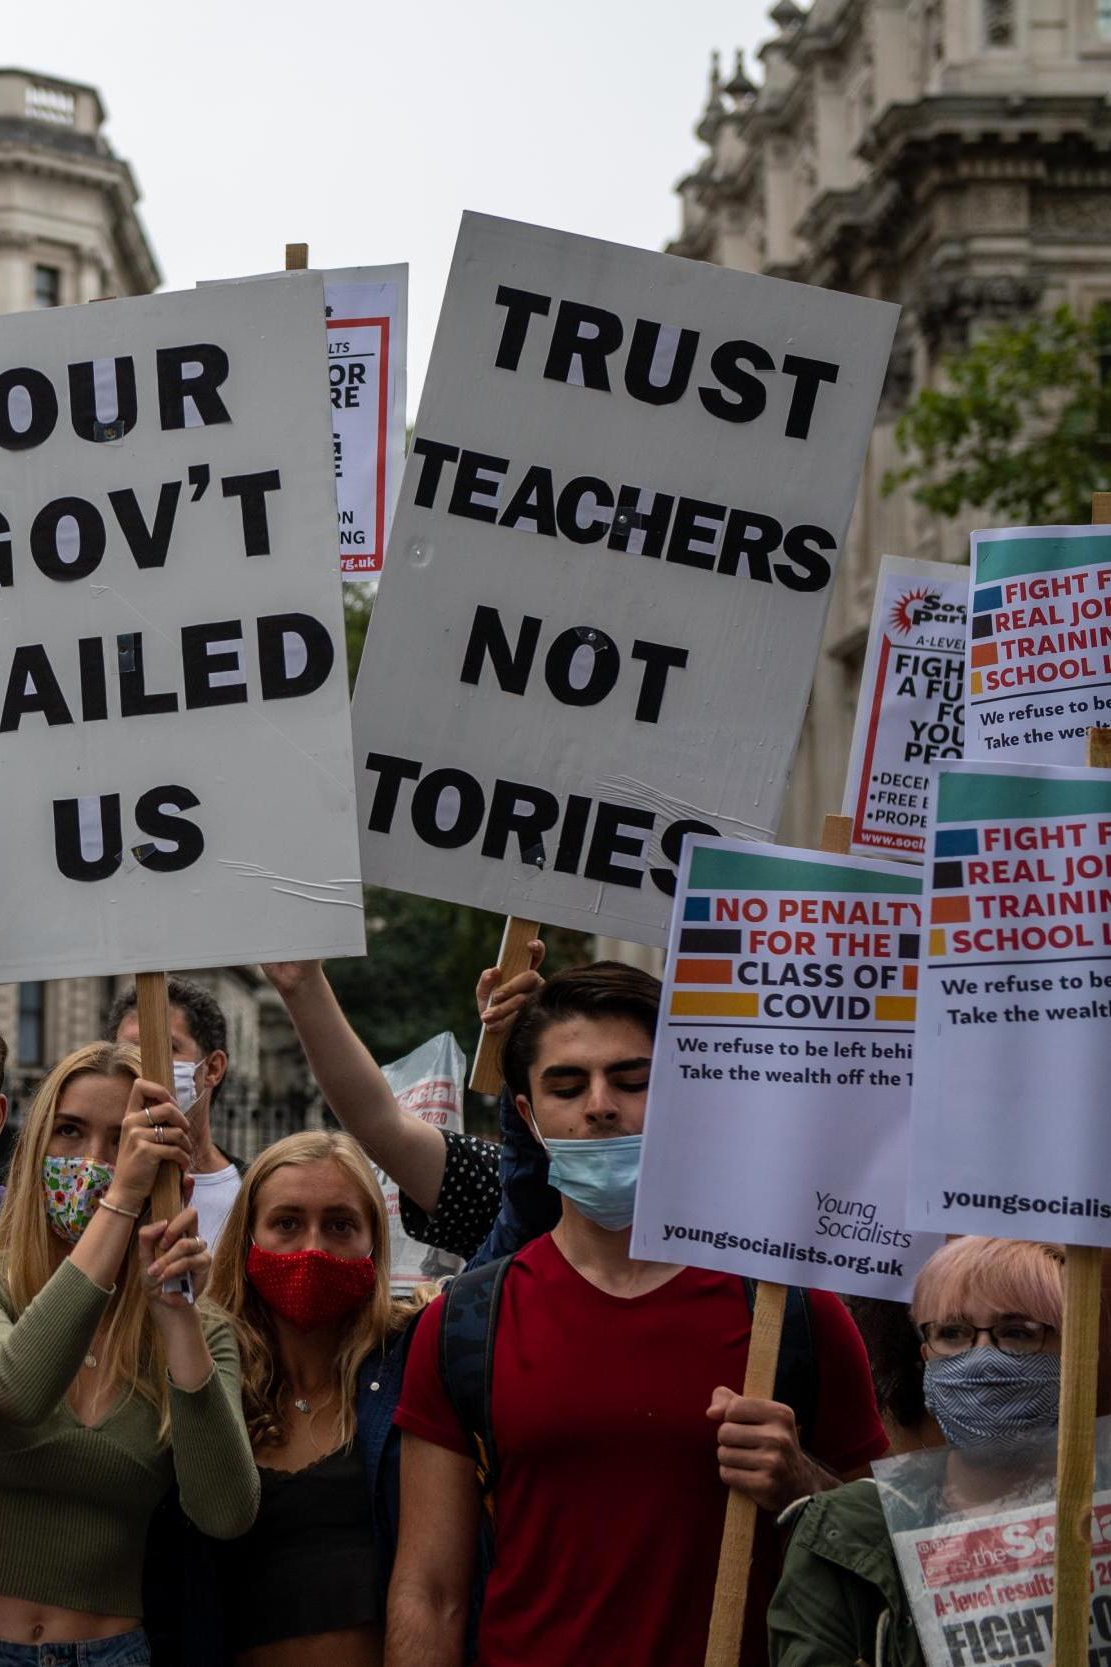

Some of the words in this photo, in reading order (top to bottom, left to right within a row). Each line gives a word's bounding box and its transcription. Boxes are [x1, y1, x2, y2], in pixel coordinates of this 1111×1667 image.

[494, 285, 840, 440] TRUST
[413, 437, 838, 593] TEACHERS
[1005, 573, 1088, 604] FIGHT
[995, 605, 1064, 633] REAL
[459, 604, 689, 724] NOT
[986, 657, 1096, 691] SCHOOL
[896, 676, 917, 698] A
[980, 711, 1004, 726] We
[1008, 704, 1064, 722] refuse
[1068, 701, 1088, 713] to
[985, 733, 1019, 750] Take
[1023, 729, 1053, 743] the
[878, 791, 918, 808] FREE
[53, 785, 205, 882] US
[365, 751, 722, 899] TORIES
[984, 824, 1086, 851] FIGHT
[968, 859, 1055, 885] REAL
[715, 898, 768, 923] NO
[779, 899, 922, 928] PENALTY
[749, 930, 816, 956] FOR
[826, 932, 891, 958] THE
[952, 924, 1094, 953] SCHOOL
[737, 961, 845, 989] CLASS
[854, 964, 898, 990] OF
[941, 979, 978, 995] We
[984, 974, 1053, 993] refuse
[1059, 975, 1083, 990] to
[1089, 970, 1111, 988] be
[763, 993, 871, 1020] COVID
[947, 1006, 999, 1025] Take
[1004, 1004, 1040, 1022] the
[677, 1037, 708, 1053] We
[713, 1037, 774, 1056] refuse
[779, 1042, 799, 1056] to
[805, 1040, 829, 1057] be
[834, 1041, 866, 1059] left
[679, 1064, 724, 1080] Take
[728, 1064, 761, 1081] the
[765, 1068, 832, 1085] wealth
[836, 1069, 865, 1086] off
[869, 1070, 902, 1086] the
[816, 1191, 877, 1226] Young
[815, 1215, 912, 1249] Socialists
[662, 1224, 904, 1277] youngsocialists.org.uk
[973, 1546, 1007, 1567] the
[933, 1584, 996, 1617] A-level
